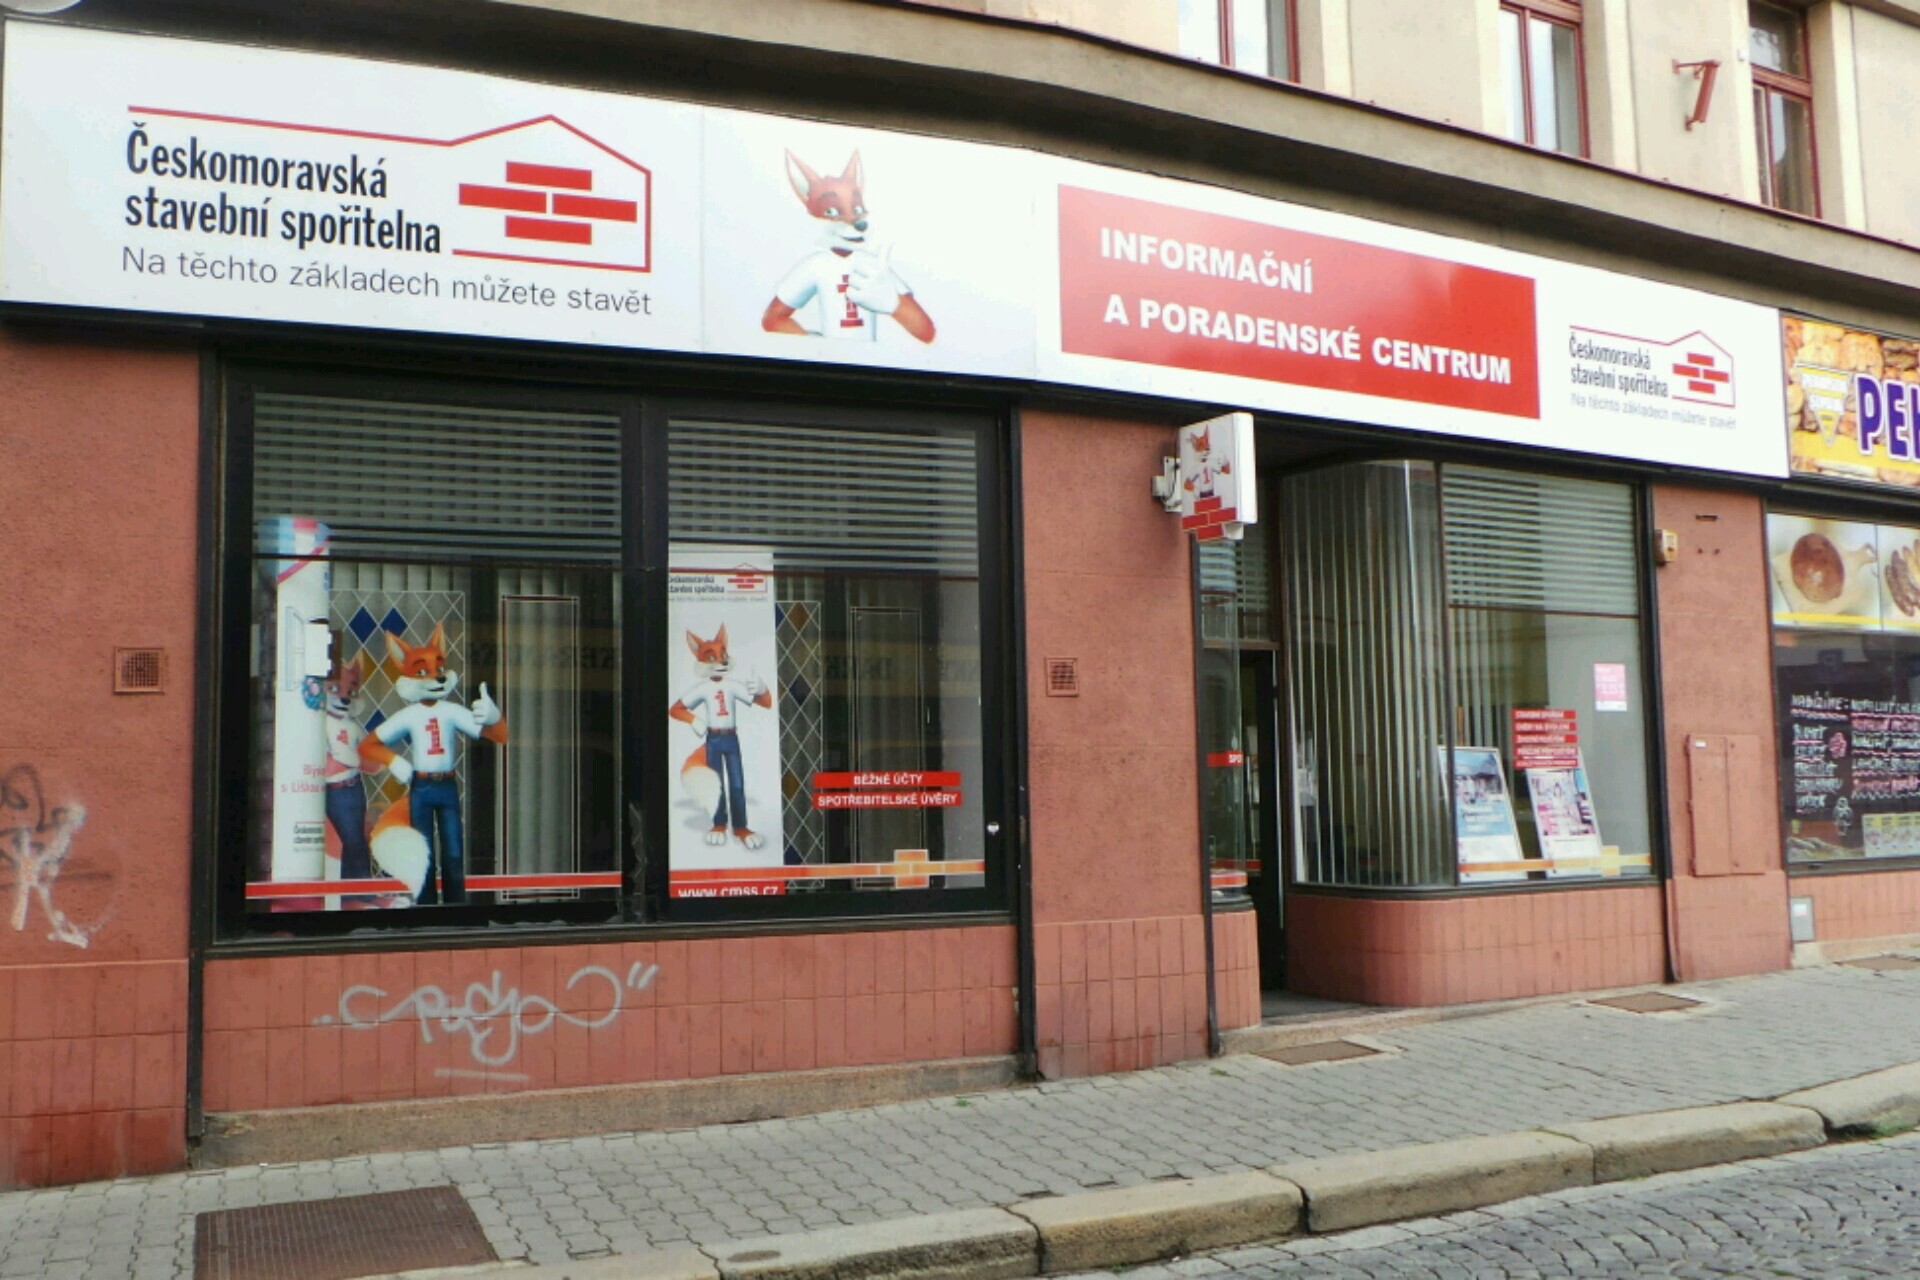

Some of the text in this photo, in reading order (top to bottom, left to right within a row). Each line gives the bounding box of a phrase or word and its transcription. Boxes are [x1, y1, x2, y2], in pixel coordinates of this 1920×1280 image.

[126, 122, 387, 198] Českomoravská
[124, 190, 441, 253] stavební spořitelna
[122, 246, 652, 316] Na těchto základech můžete stavět
[1100, 226, 1313, 294] INFORMAČNÍ
[1104, 294, 1511, 384] A PORADENSKÉ CENTRUM
[1569, 331, 1651, 370] Českomoravská
[1571, 363, 1668, 397] stavební spořitelna
[818, 791, 957, 807] SPOTŘEBITELSKÉ ÚVĚRY
[853, 771, 923, 786] BĚŽNÉ ÚČTY
